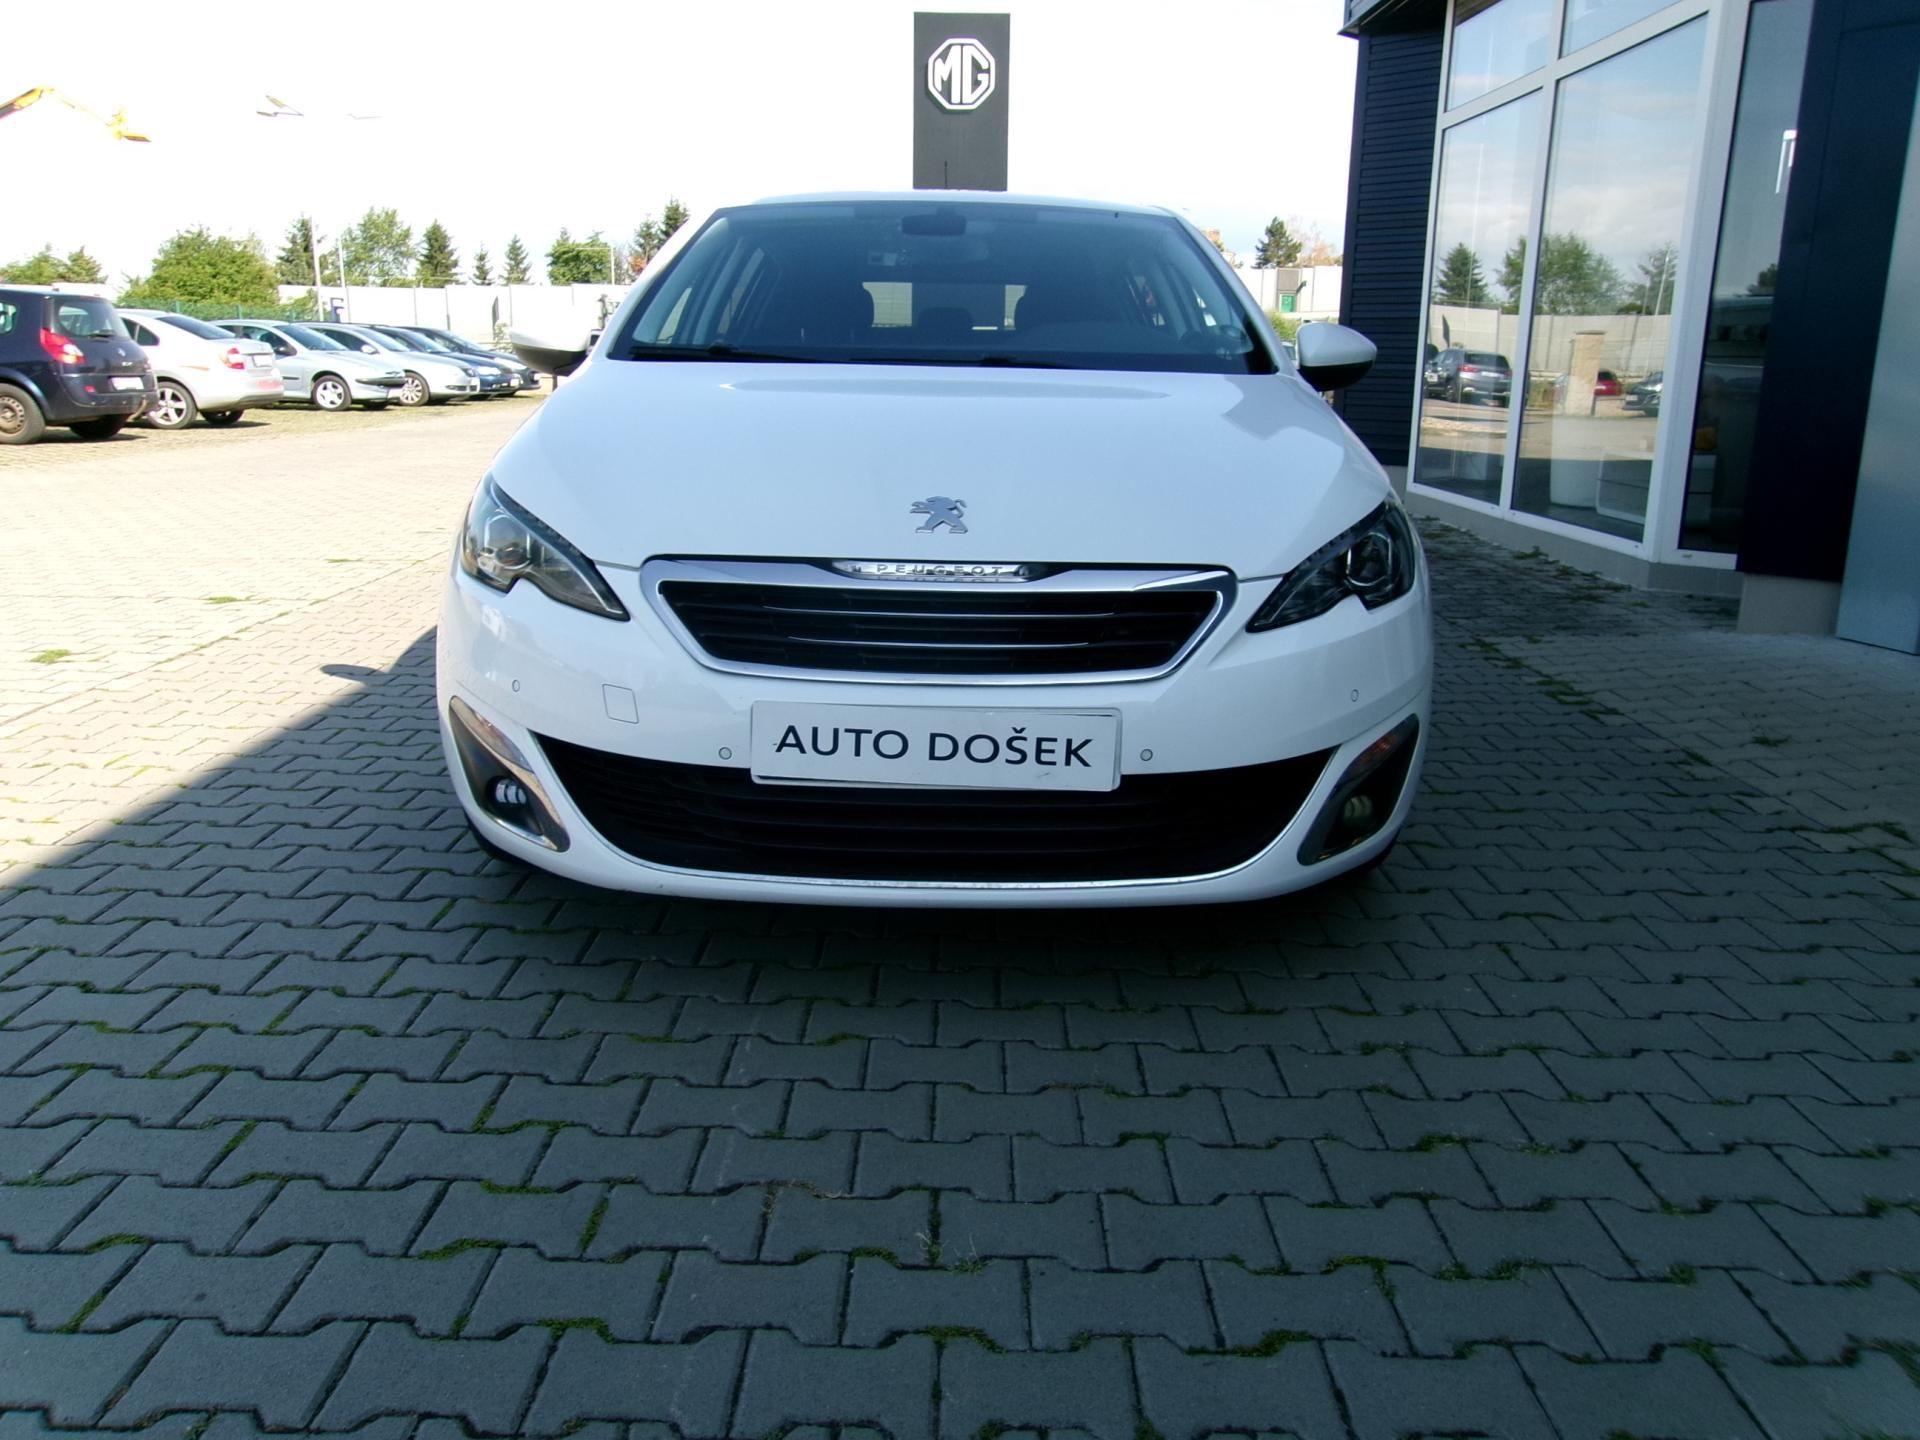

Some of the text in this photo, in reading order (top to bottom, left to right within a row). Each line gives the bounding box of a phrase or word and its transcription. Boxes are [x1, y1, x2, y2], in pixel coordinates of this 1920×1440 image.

[933, 44, 991, 105] MG
[876, 564, 1003, 575] PEUGEOT
[775, 724, 1094, 767] AUTO DOŠEK
